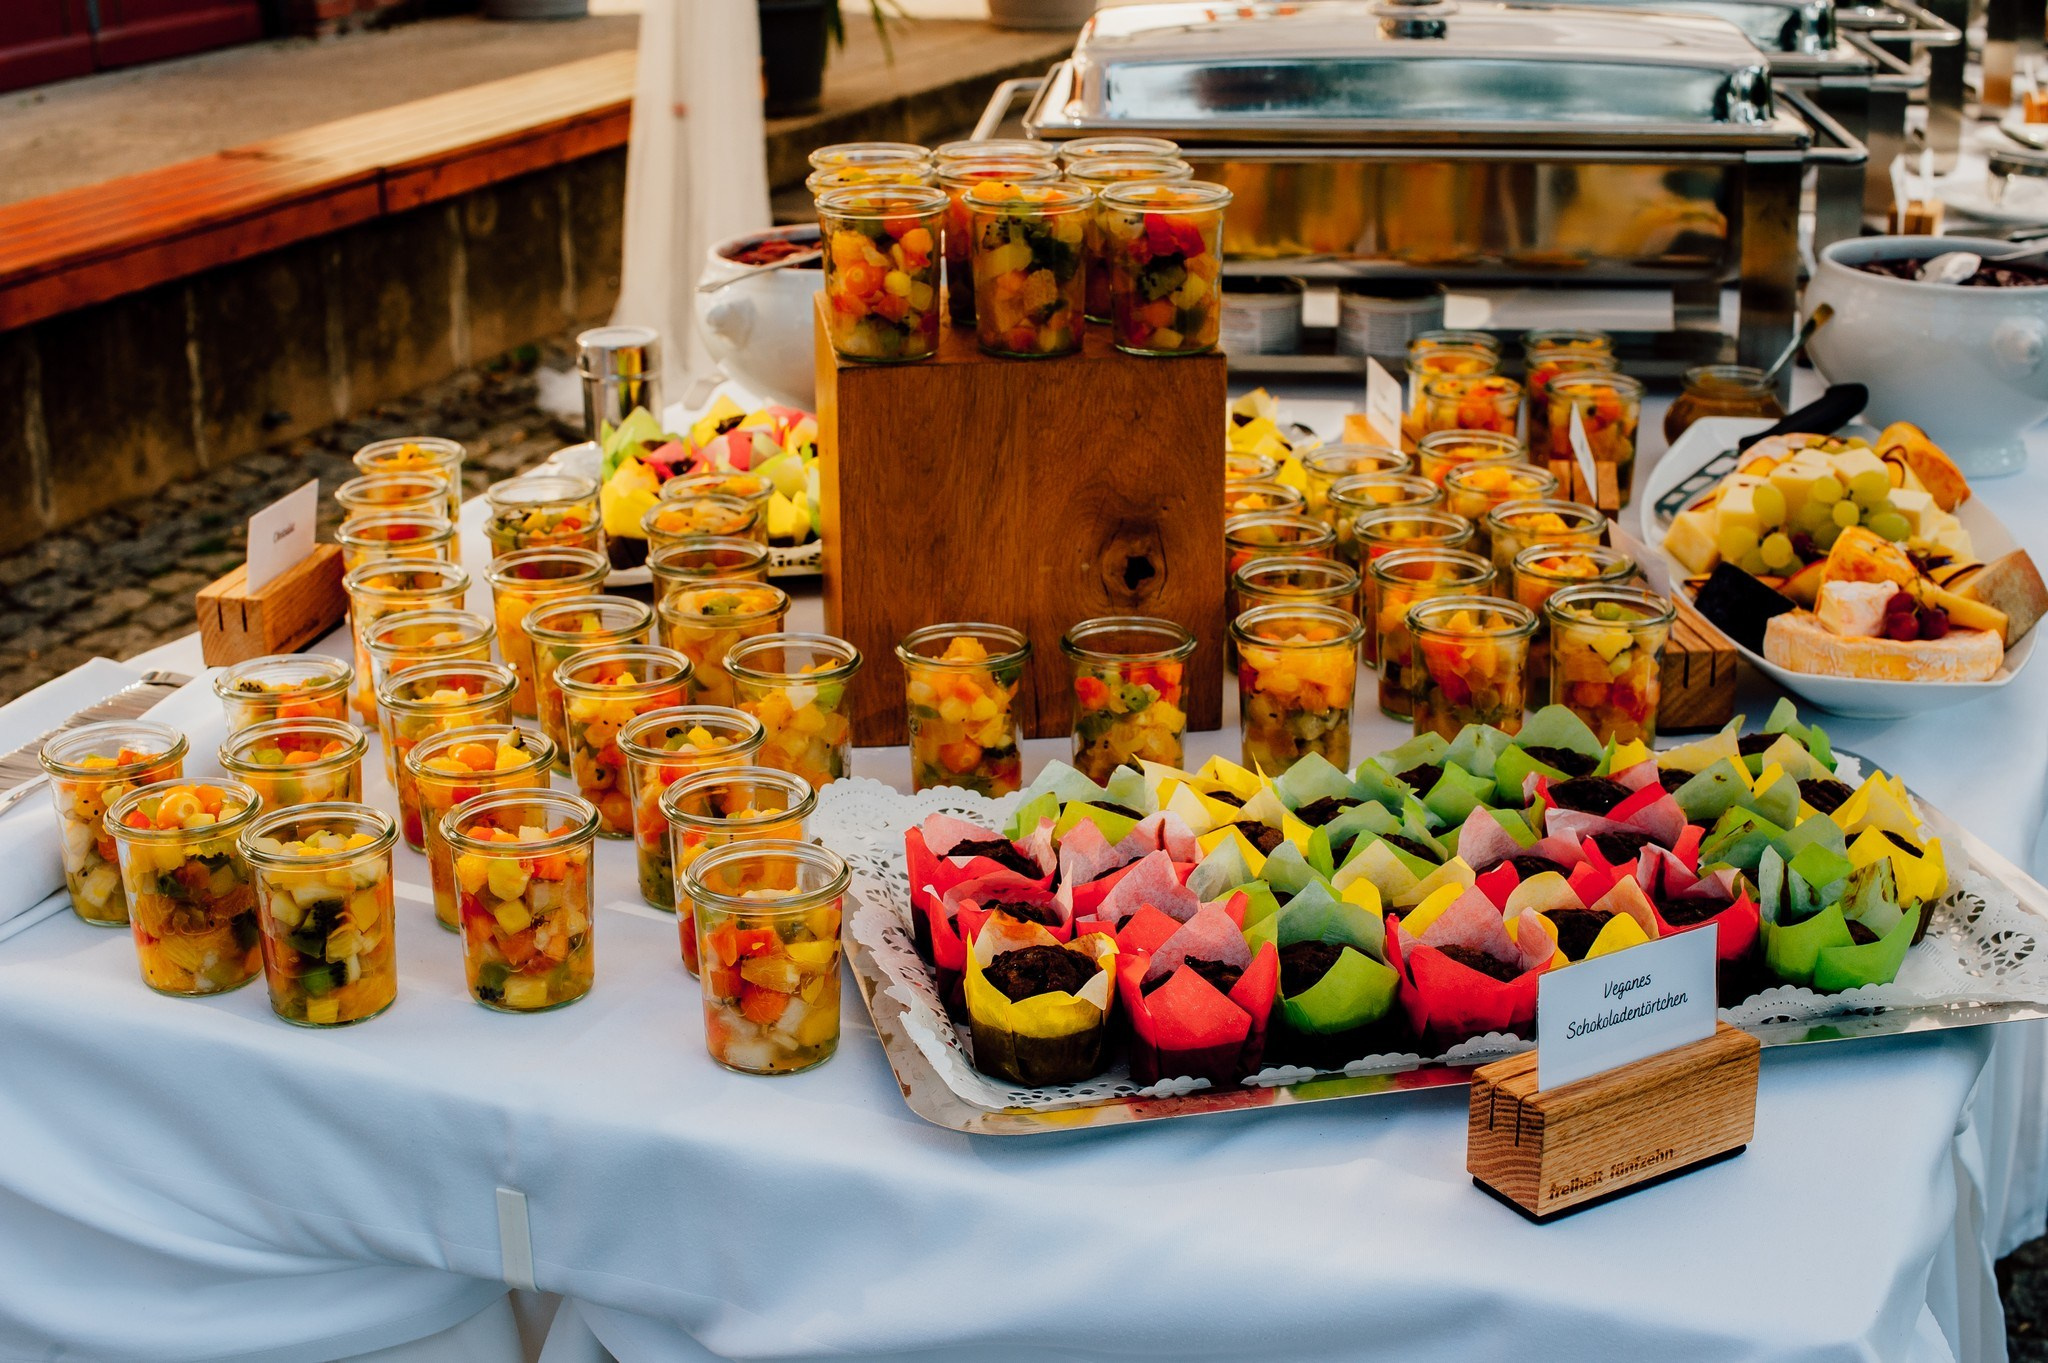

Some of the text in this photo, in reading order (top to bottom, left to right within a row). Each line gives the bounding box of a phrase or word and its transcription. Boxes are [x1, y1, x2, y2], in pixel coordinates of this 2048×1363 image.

[1603, 973, 1652, 1000] Veganes
[1566, 990, 1688, 1040] Schokoladentörtchen
[1548, 1147, 1675, 1201] freiheit fünfzehn
